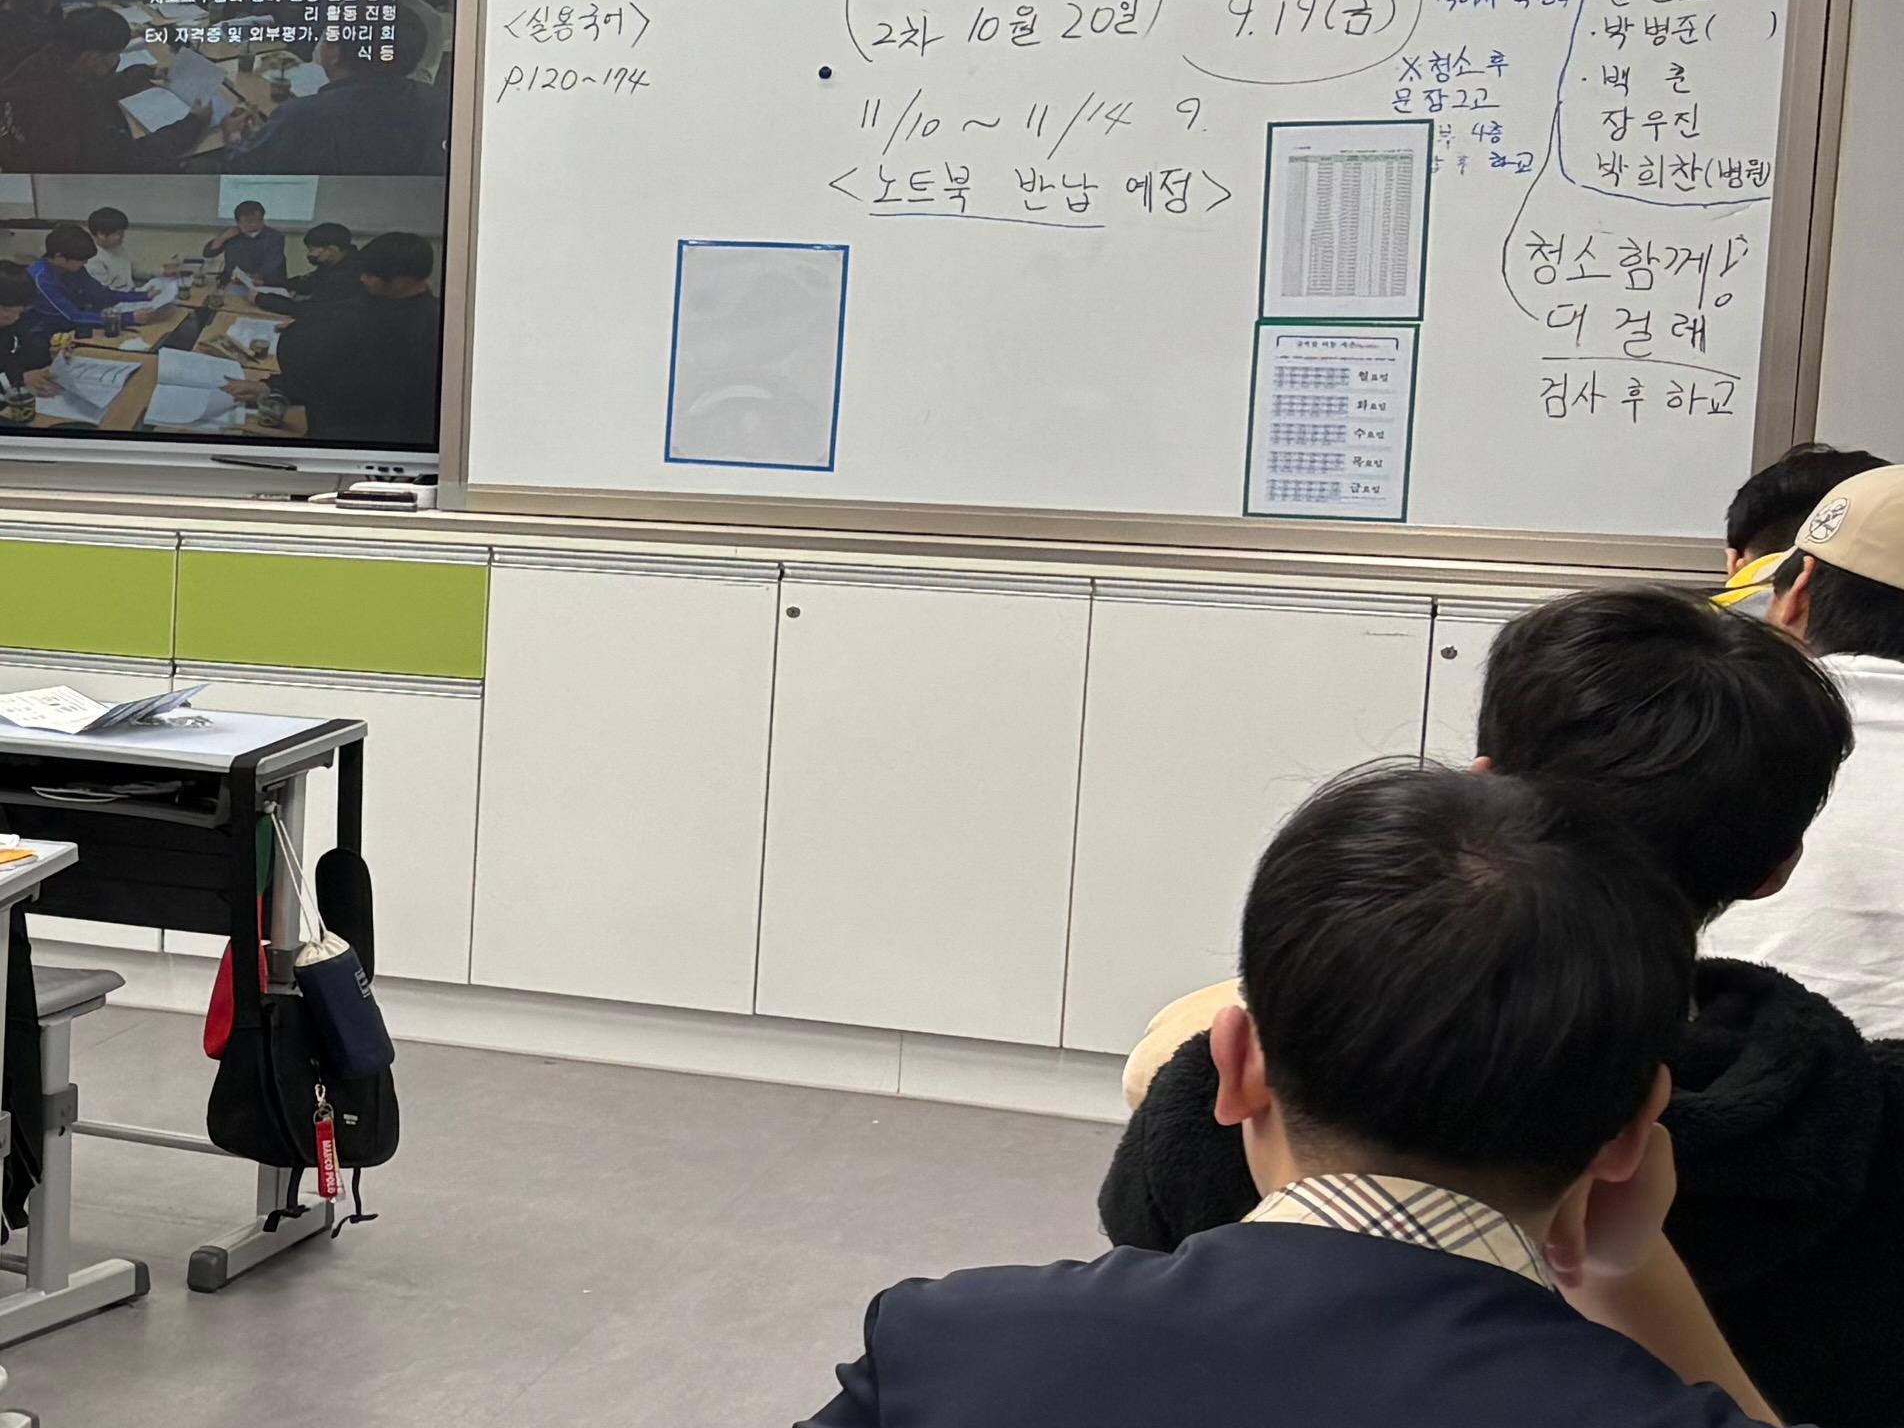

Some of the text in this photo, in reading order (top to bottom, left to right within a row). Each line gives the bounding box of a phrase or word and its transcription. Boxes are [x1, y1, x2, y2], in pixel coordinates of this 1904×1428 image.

[304, 4, 398, 22] 리 활동 진행
[967, 4, 1041, 48] 10월
[175, 27, 221, 44] 자격증
[227, 27, 242, 44] 및
[325, 24, 373, 42] 동아리
[1604, 15, 1635, 50] 박
[357, 44, 395, 61] 식 등
[1429, 44, 1486, 84] 청소
[1486, 50, 1510, 78] 후
[1392, 88, 1412, 113] 문
[1014, 167, 1099, 214] 반납
[1525, 230, 1612, 285] 청소
[1540, 370, 1735, 423] 검사 후 하교
